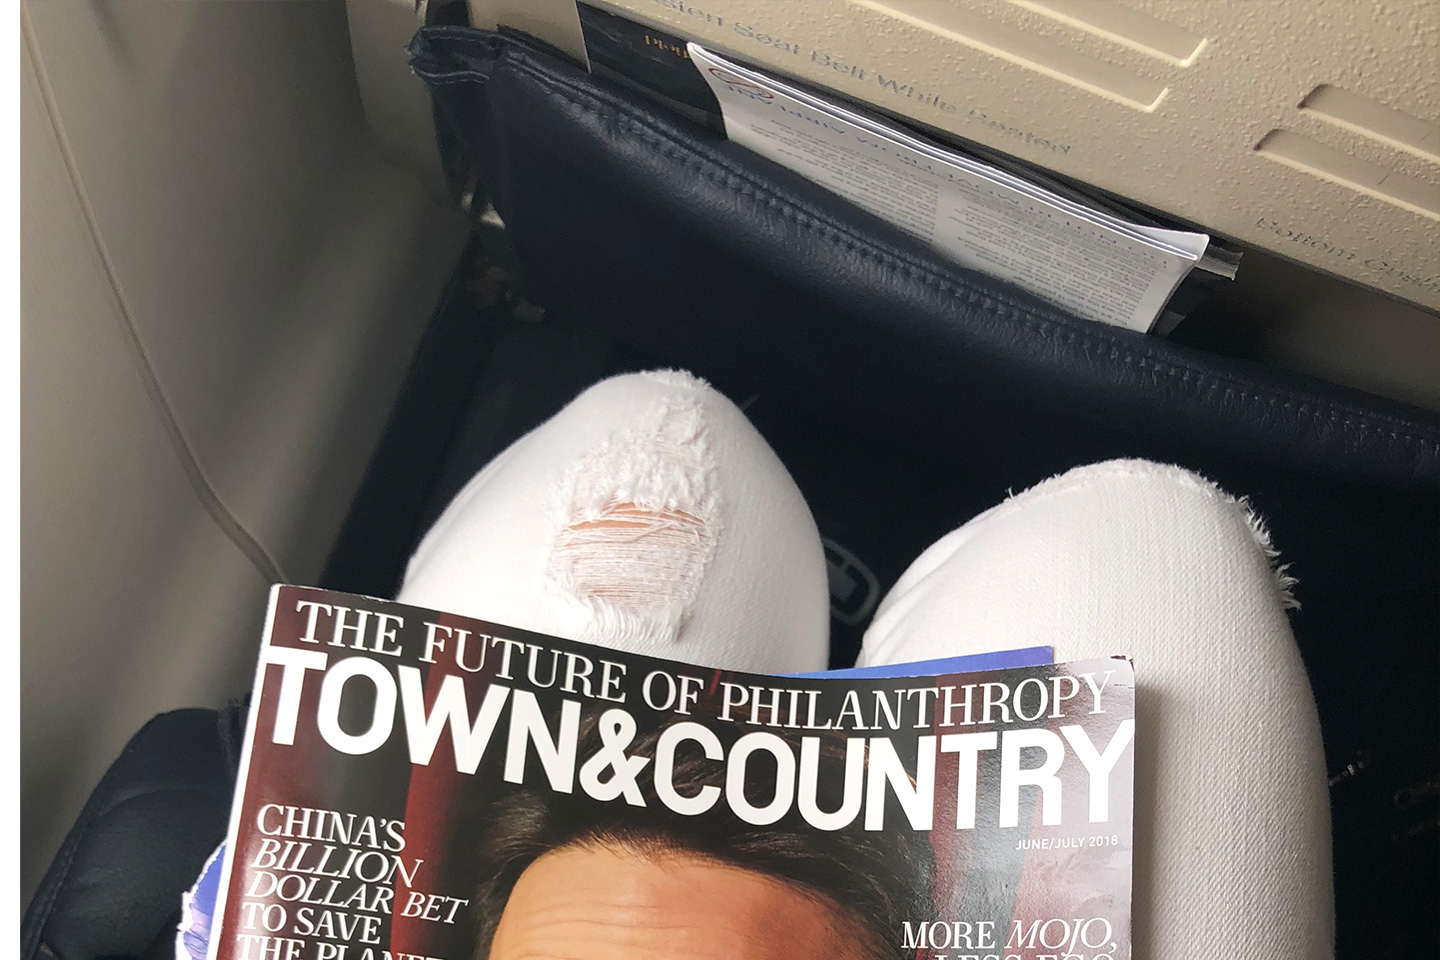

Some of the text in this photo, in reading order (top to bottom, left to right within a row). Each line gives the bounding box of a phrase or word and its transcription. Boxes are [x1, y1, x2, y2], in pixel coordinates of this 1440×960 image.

[734, 22, 800, 56] Seat
[811, 50, 864, 80] Belt
[877, 74, 957, 113] While
[296, 600, 1118, 731] THE FUTURE OF PHILANTHROPY
[264, 644, 1135, 832] TOWN&COUNTRY
[256, 803, 407, 852] CHINA'S
[1014, 834, 1119, 851] JUNE/JULY 2018
[250, 838, 424, 888] BILLION
[244, 870, 469, 925] DOLLAR BET
[242, 902, 382, 944] TO SAVE
[900, 917, 1118, 957] MORE MOJO,
